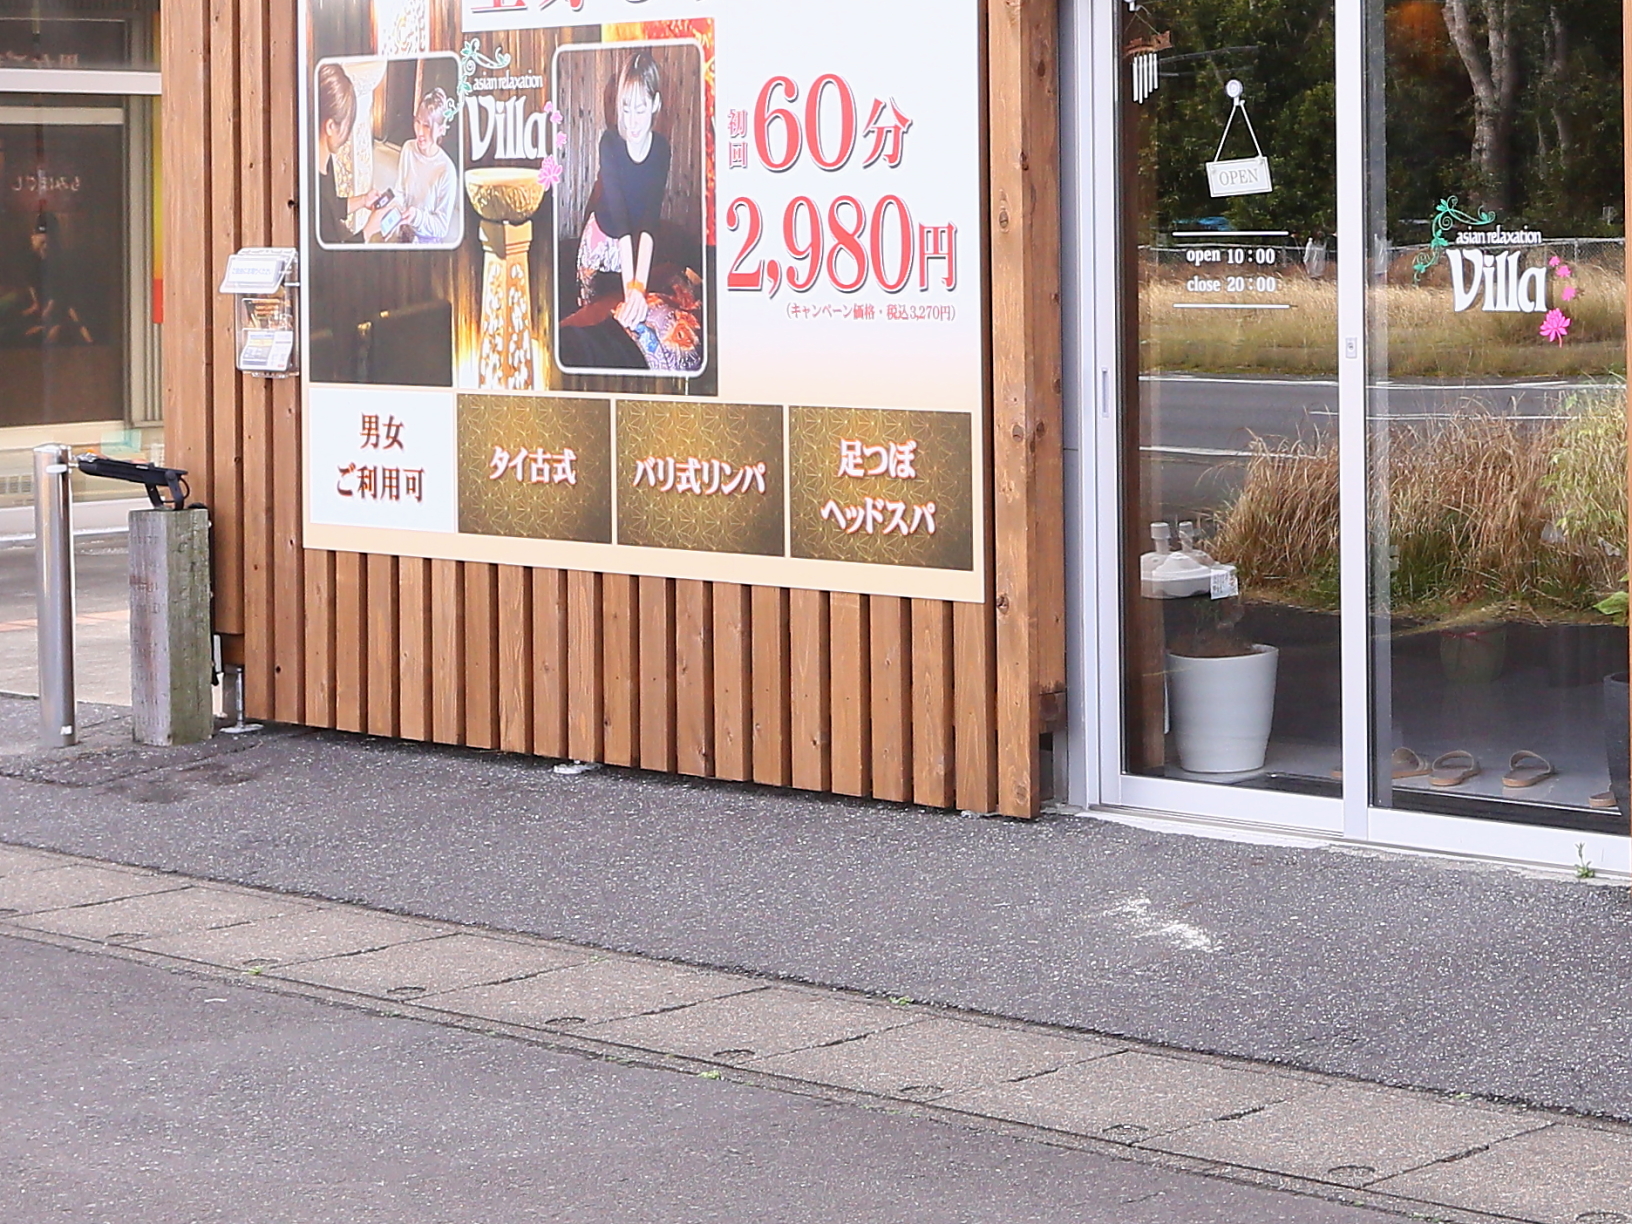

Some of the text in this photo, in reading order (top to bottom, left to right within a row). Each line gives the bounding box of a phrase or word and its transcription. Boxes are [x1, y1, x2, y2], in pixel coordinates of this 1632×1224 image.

[473, 69, 543, 91] asian relaxation
[466, 95, 548, 162] Villa
[754, 73, 913, 173] 60分
[1219, 168, 1259, 188] OPEN
[727, 194, 957, 299] 2,980円
[1456, 225, 1542, 245] asian relaxation
[1186, 247, 1276, 266] open 10:00
[1186, 275, 1277, 293] close 20:00
[1446, 248, 1548, 314] Villa
[359, 412, 404, 450] 男女
[488, 446, 577, 486] タイ古式
[633, 456, 767, 496] バリ式リンパ
[837, 437, 917, 480] 足つぼ
[335, 464, 425, 503] ご利用可
[820, 496, 937, 537] ヘッドスパ
